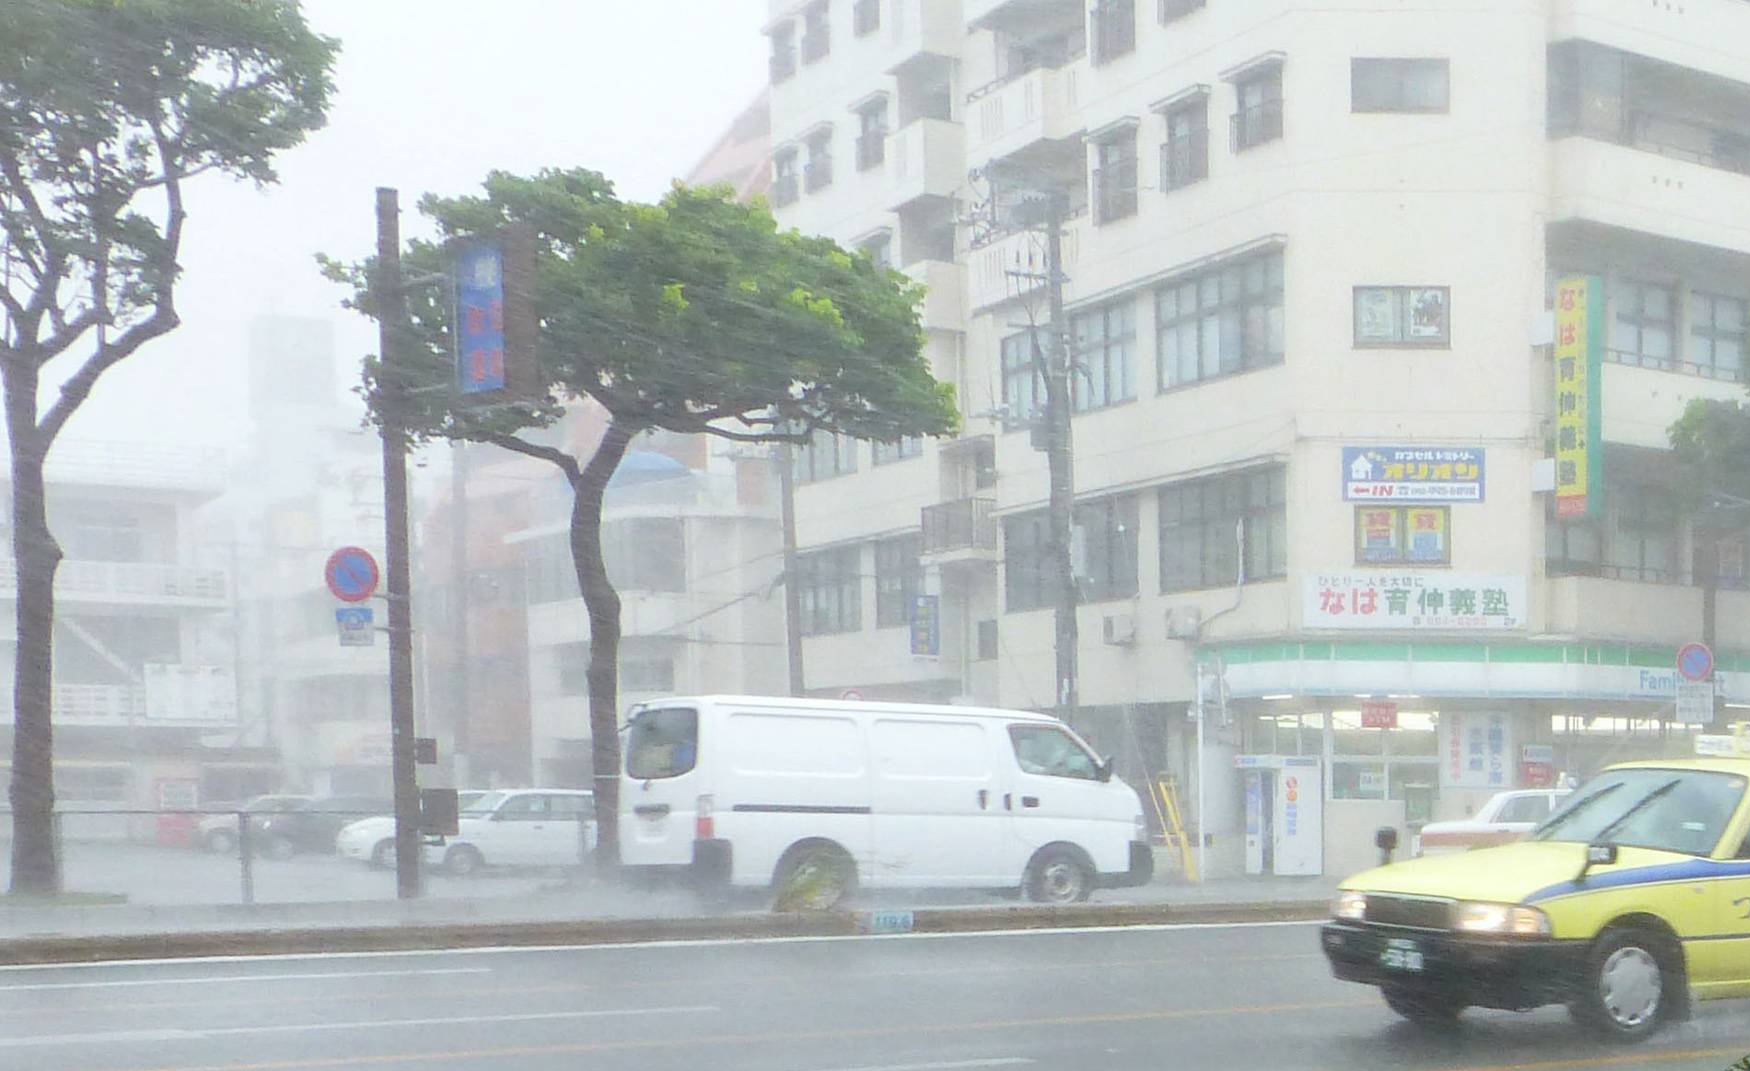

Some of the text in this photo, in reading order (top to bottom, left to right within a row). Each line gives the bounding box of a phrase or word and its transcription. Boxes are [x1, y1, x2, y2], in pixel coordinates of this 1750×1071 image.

[1382, 463, 1478, 480] オリオン
[1372, 485, 1393, 496] IN
